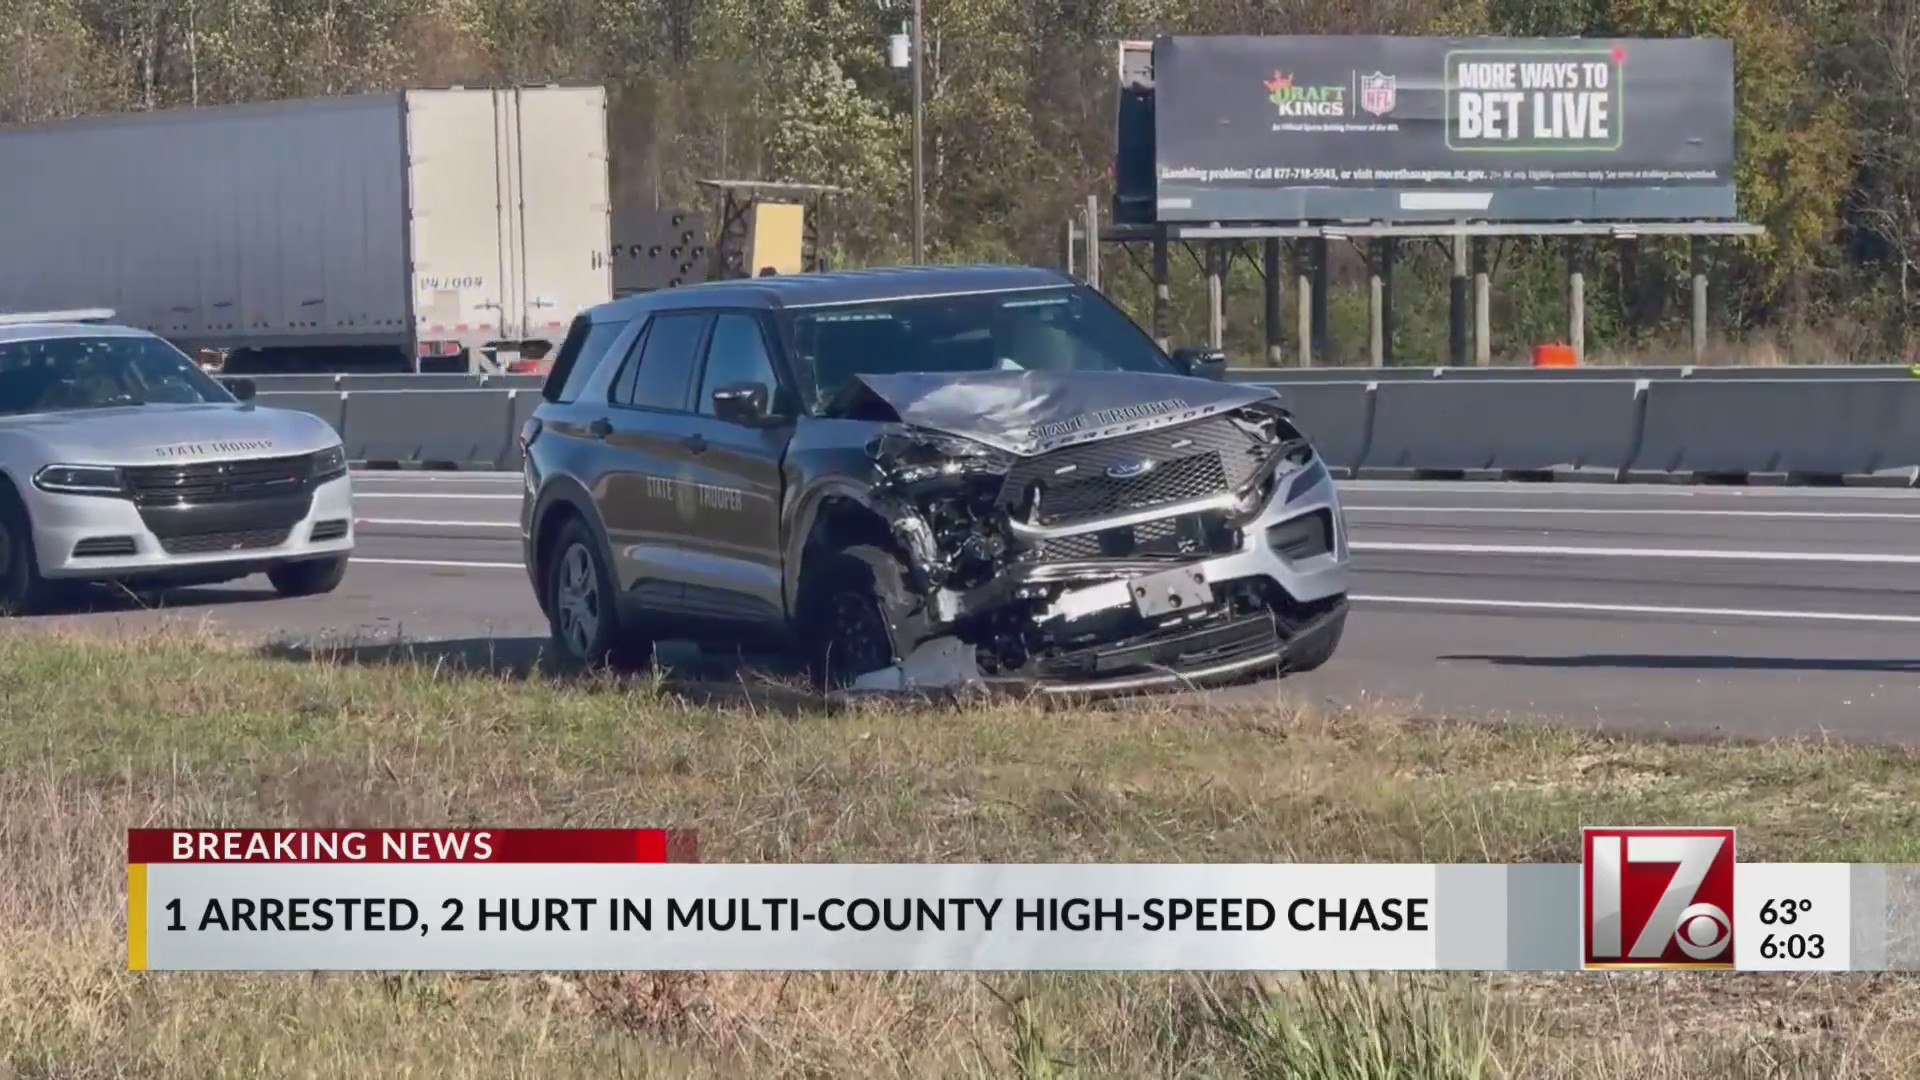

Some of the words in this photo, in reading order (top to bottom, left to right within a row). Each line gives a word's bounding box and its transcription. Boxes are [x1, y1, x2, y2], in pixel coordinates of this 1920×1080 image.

[1458, 63, 1516, 89] MORE
[1520, 63, 1579, 89] WAYS
[1582, 62, 1609, 89] TO
[1269, 86, 1346, 104] DRAFT
[1278, 102, 1345, 116] KINGS
[1458, 92, 1525, 139] BET
[1533, 91, 1609, 139] LIVE
[1208, 168, 1253, 181] problem?
[1255, 168, 1272, 179] Call
[1340, 171, 1351, 179] or
[1353, 169, 1372, 179] visit
[1027, 415, 1086, 441] STATE
[1097, 398, 1188, 425] TROOPER
[154, 445, 204, 457] STATE
[211, 440, 273, 453] TROOPER
[646, 475, 673, 501] STATE
[699, 483, 742, 512] TROOPER
